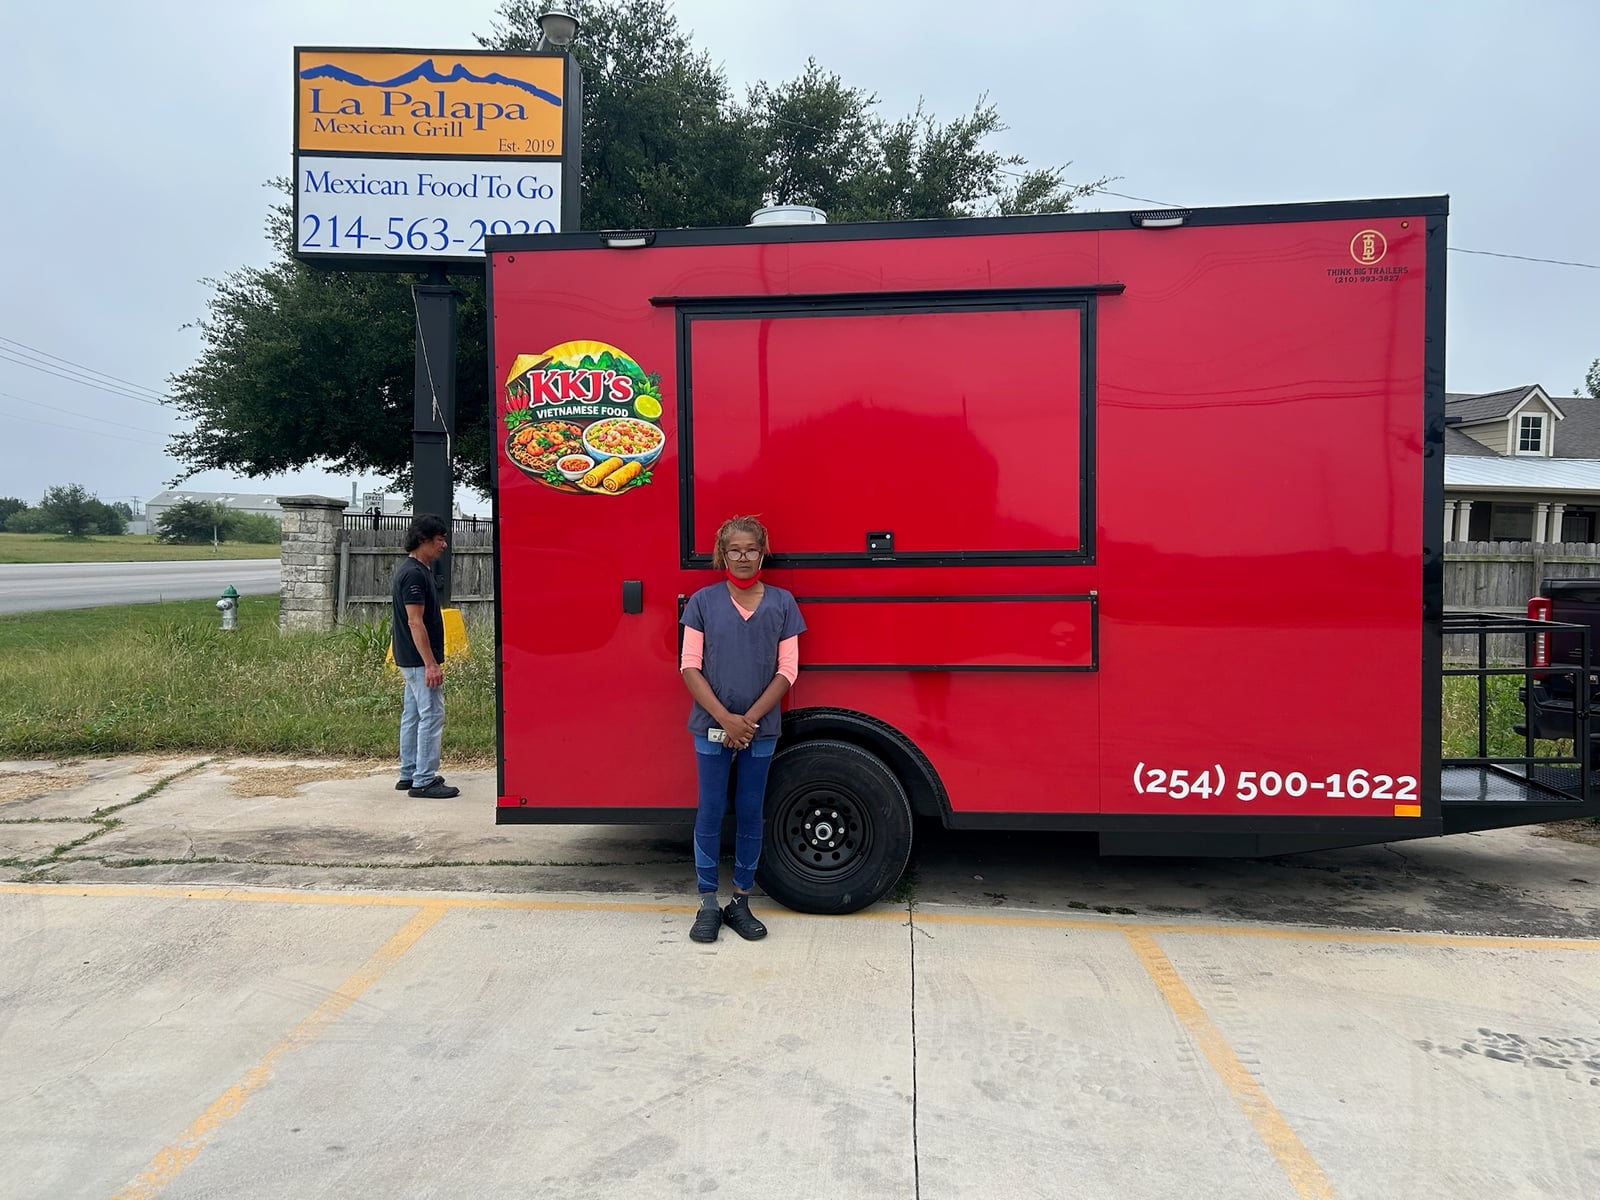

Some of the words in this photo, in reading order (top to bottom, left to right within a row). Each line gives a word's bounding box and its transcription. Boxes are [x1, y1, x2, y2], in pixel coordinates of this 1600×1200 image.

[309, 88, 364, 116] La
[380, 90, 529, 131] Palapa
[313, 117, 405, 136] Mexican
[413, 120, 464, 138] Grill
[498, 138, 521, 152] Est.
[524, 138, 555, 153] 2019
[303, 170, 409, 196] Mexican
[416, 173, 478, 198] Food
[480, 175, 511, 199] To
[516, 175, 554, 200] Go
[1327, 268, 1352, 276] THINK
[1354, 267, 1367, 275] BIG
[1368, 266, 1409, 275] TRAILERS
[1334, 276, 1358, 284] (210)
[536, 405, 599, 419] VIETNAMESE
[601, 406, 629, 418] FOOD
[1133, 761, 1226, 800] (254)
[1236, 768, 1418, 801] 500-1622
